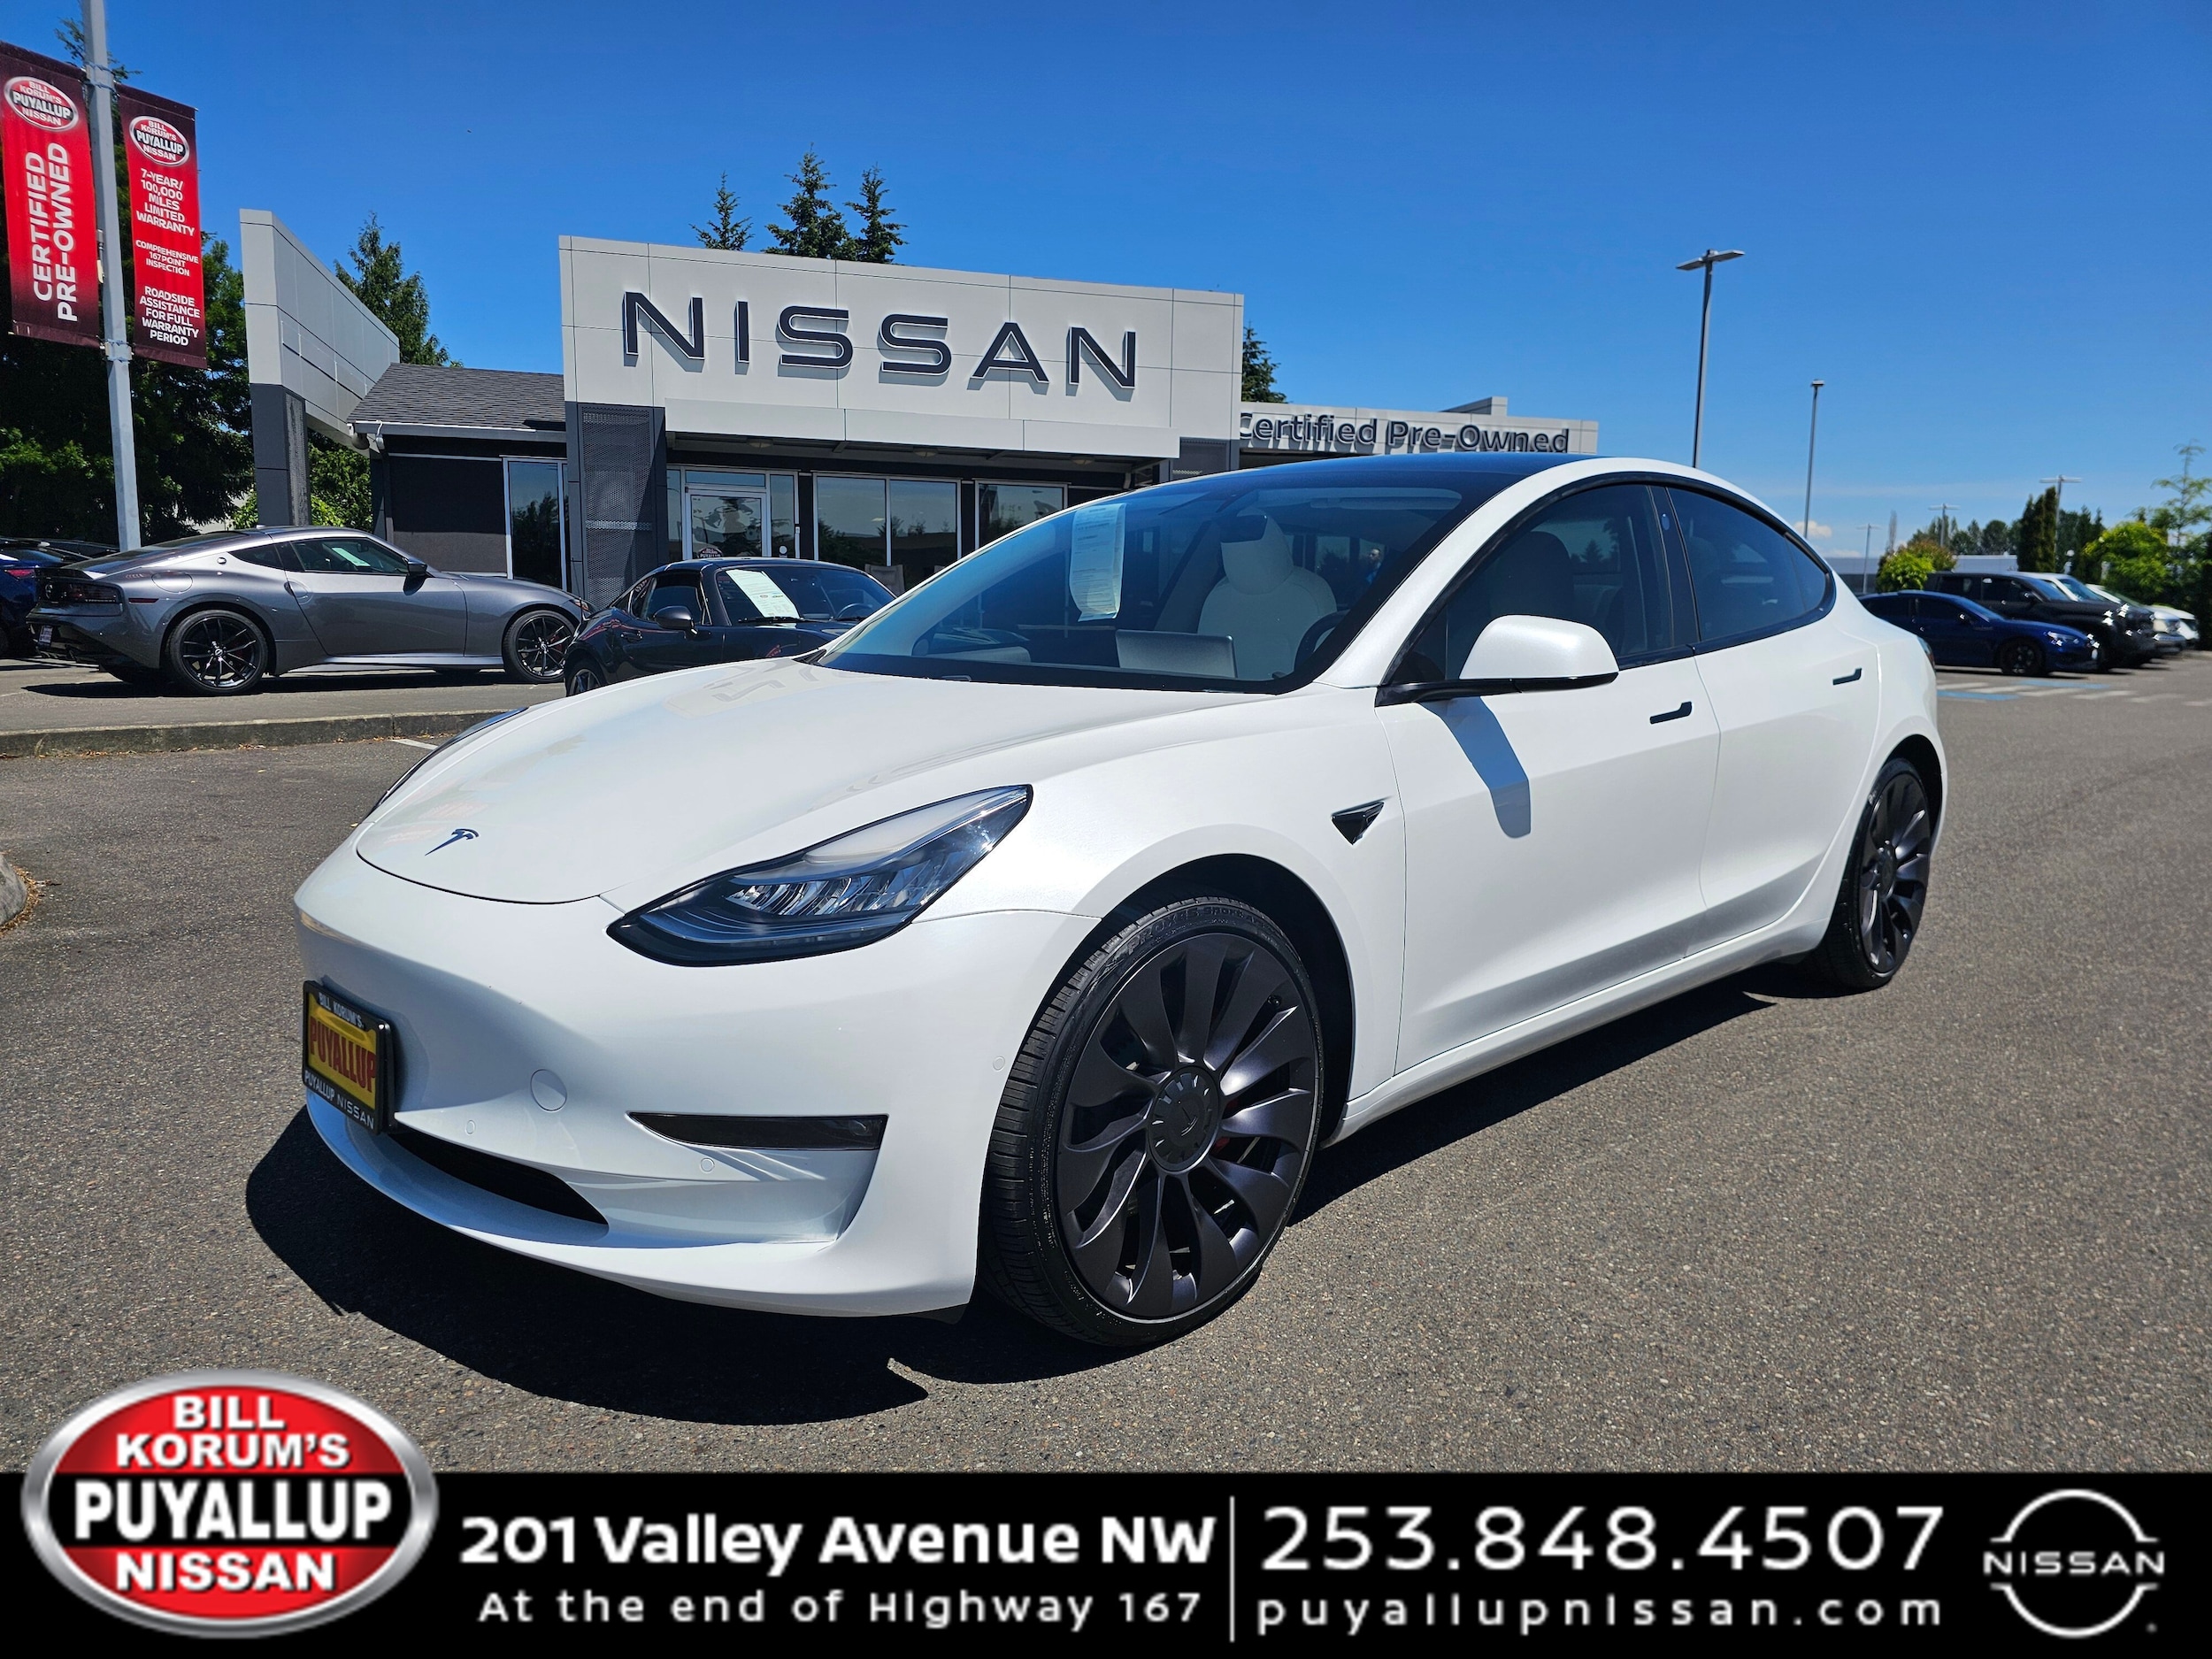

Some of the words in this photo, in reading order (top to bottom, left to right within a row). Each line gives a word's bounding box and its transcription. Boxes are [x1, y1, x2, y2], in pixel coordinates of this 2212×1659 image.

[29, 81, 50, 94] BILL
[12, 91, 71, 119] PUYALLUP
[22, 107, 61, 126] NISSAN
[148, 120, 166, 132] BILL
[136, 130, 184, 155] PUYALLUP
[141, 124, 177, 141] KORUM'S
[142, 144, 176, 161] NISSAN
[141, 168, 183, 191] 7-YEAR/
[141, 180, 183, 201] 100,000
[149, 193, 180, 211] MILES
[136, 211, 195, 236] WARRANTY
[144, 203, 185, 223] LIMITED
[26, 151, 52, 301] CERTIFIED
[48, 142, 78, 321] PRE-OWNED
[135, 240, 199, 264] COMPREHENSIVE
[149, 251, 162, 261] 167
[161, 256, 186, 267] POINT
[146, 258, 190, 276] INSPECTION
[144, 286, 195, 306] ROADSIDE
[140, 296, 201, 319] ASSISTANCE
[146, 307, 166, 320] FOR
[166, 312, 193, 327] FULL
[142, 317, 199, 338] WARRANTY
[150, 329, 188, 346] PERIOD
[623, 291, 1136, 388] NISSAN
[1387, 419, 1569, 454] Pre-Owned
[310, 1017, 377, 1094] PUYALLUP
[304, 1070, 335, 1100] PUYALLUP
[336, 1094, 375, 1131] NISSAN
